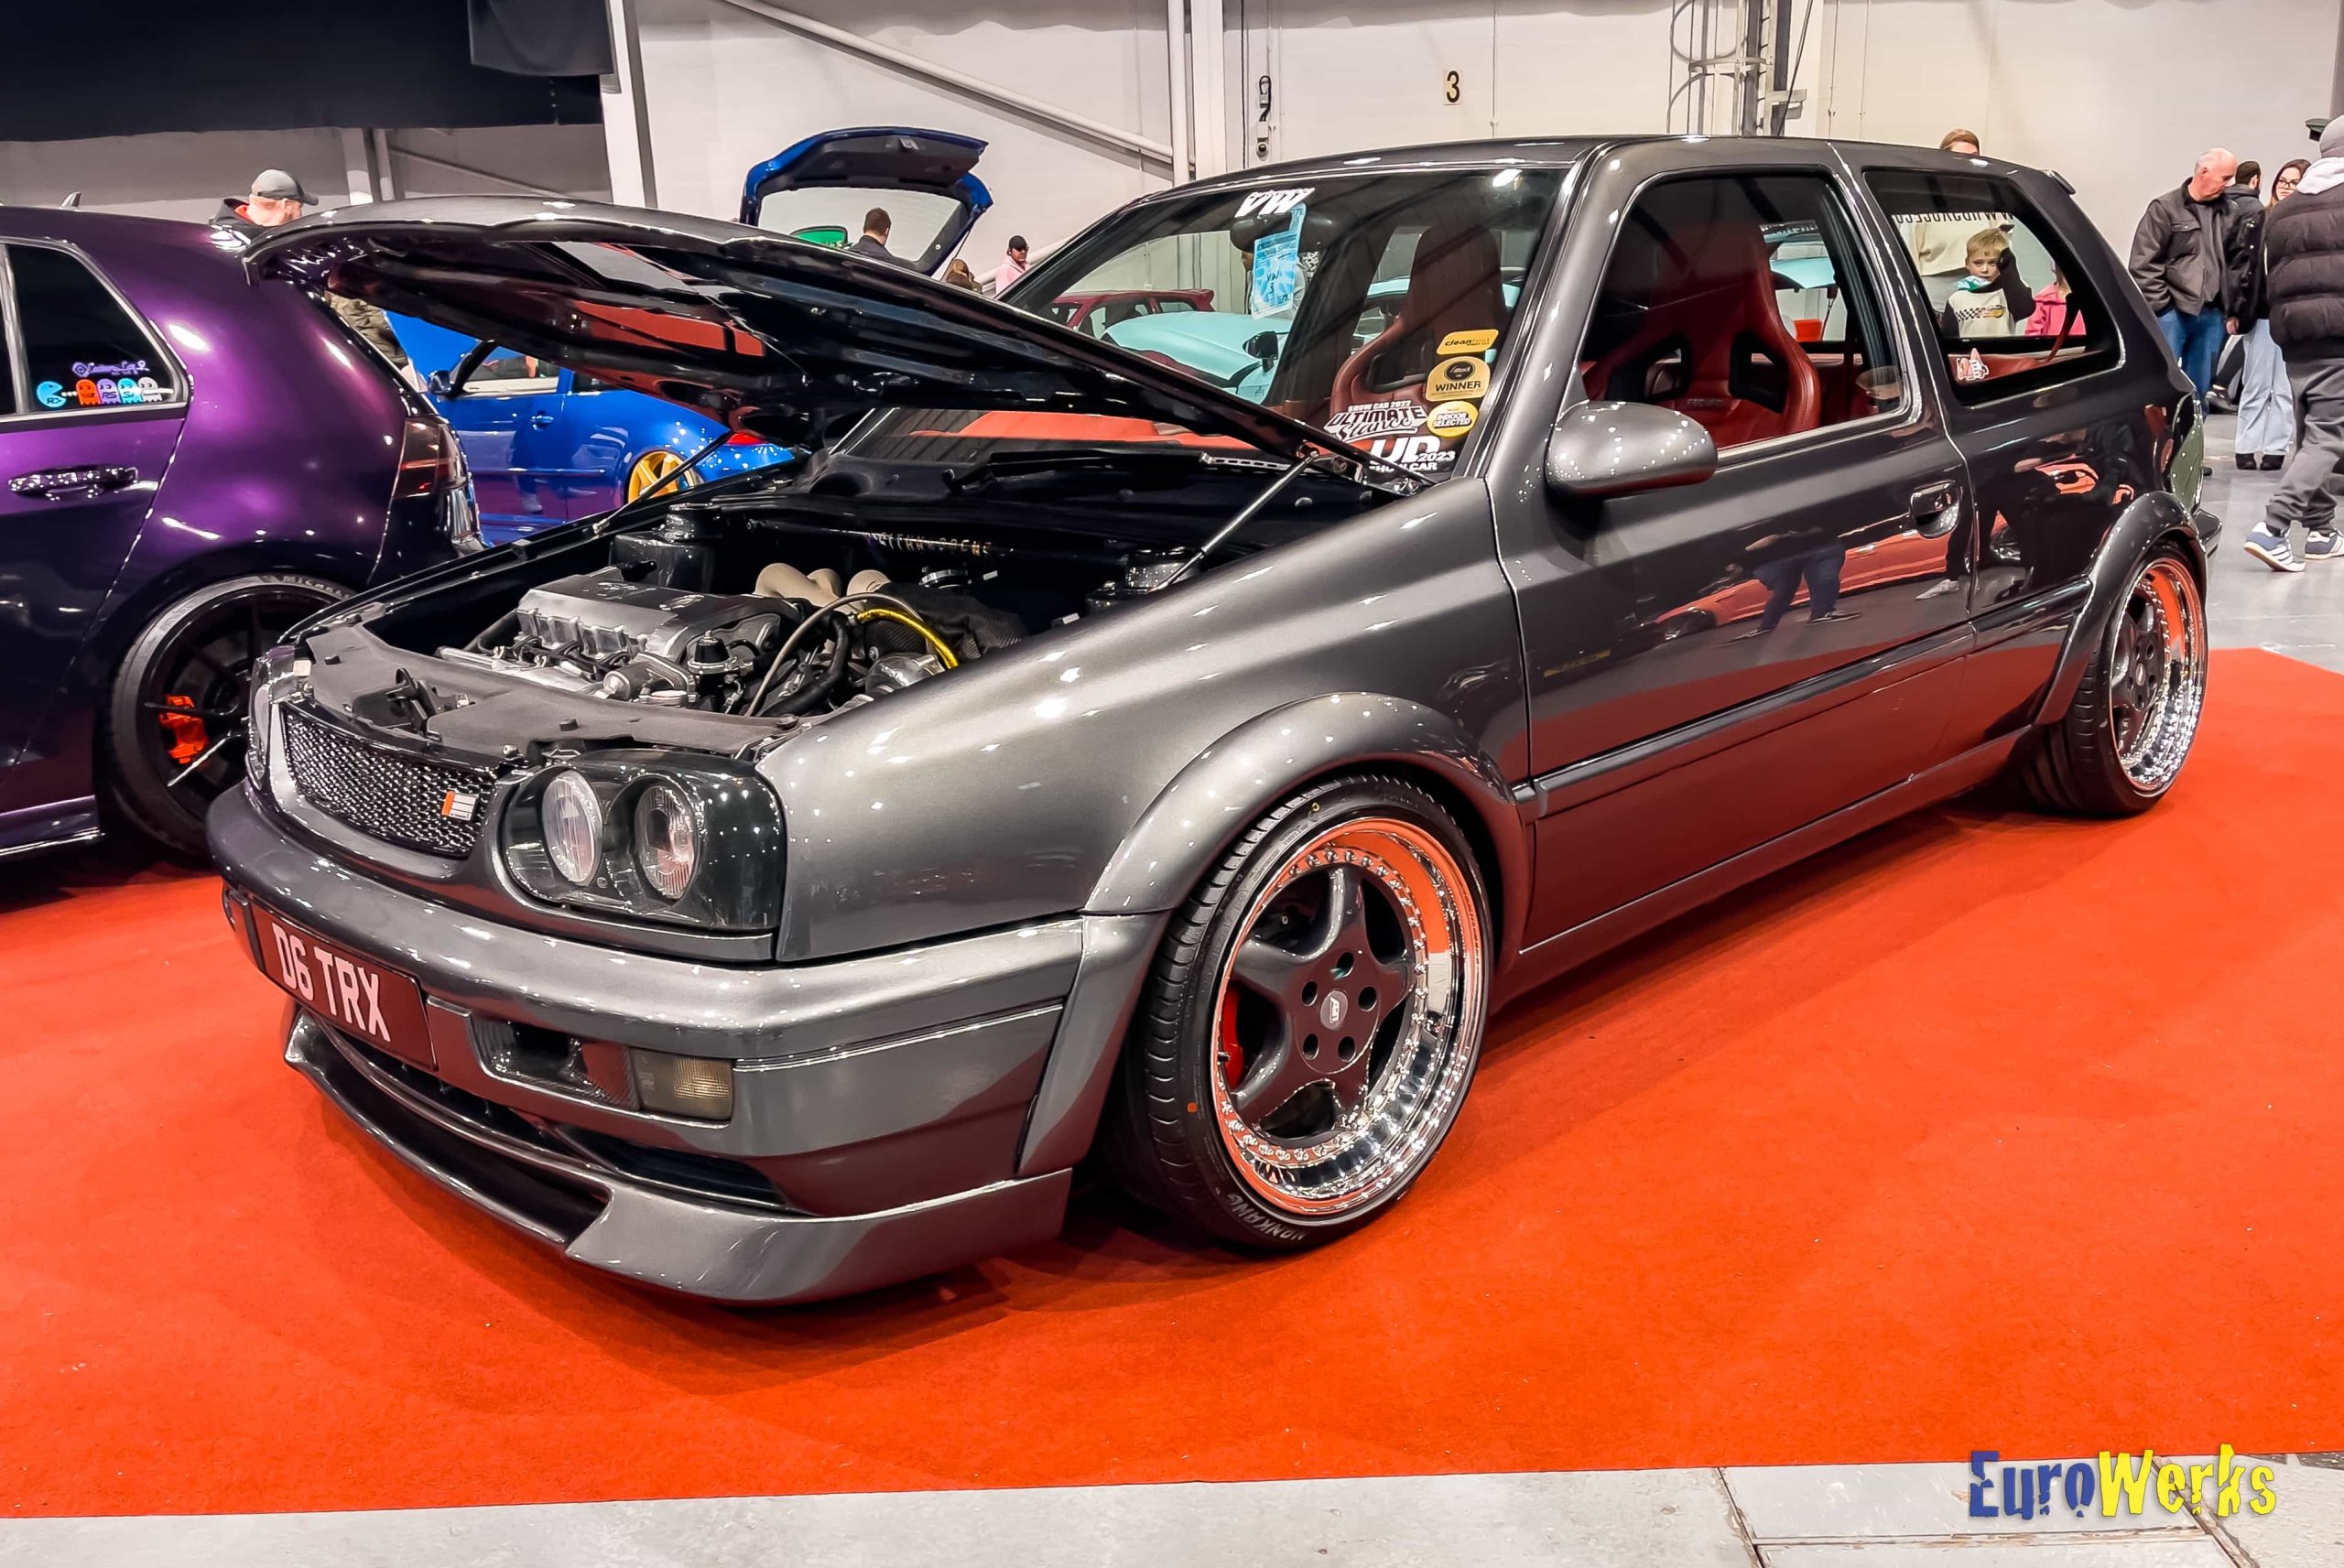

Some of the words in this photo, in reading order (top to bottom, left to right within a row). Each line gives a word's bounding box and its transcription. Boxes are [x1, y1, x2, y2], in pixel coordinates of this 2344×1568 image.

[1447, 70, 1460, 103] 3
[1234, 188, 1316, 218] VW
[1435, 381, 1481, 392] WINNER
[1328, 406, 1427, 427] ULTIMATE
[1432, 417, 1472, 427] SELECTED
[1437, 412, 1468, 420] INDOOR
[1370, 436, 1440, 463] UD
[1417, 450, 1456, 462] 2023
[1409, 462, 1438, 471] CAR
[272, 922, 313, 1001] D6
[314, 946, 391, 1042] TRX
